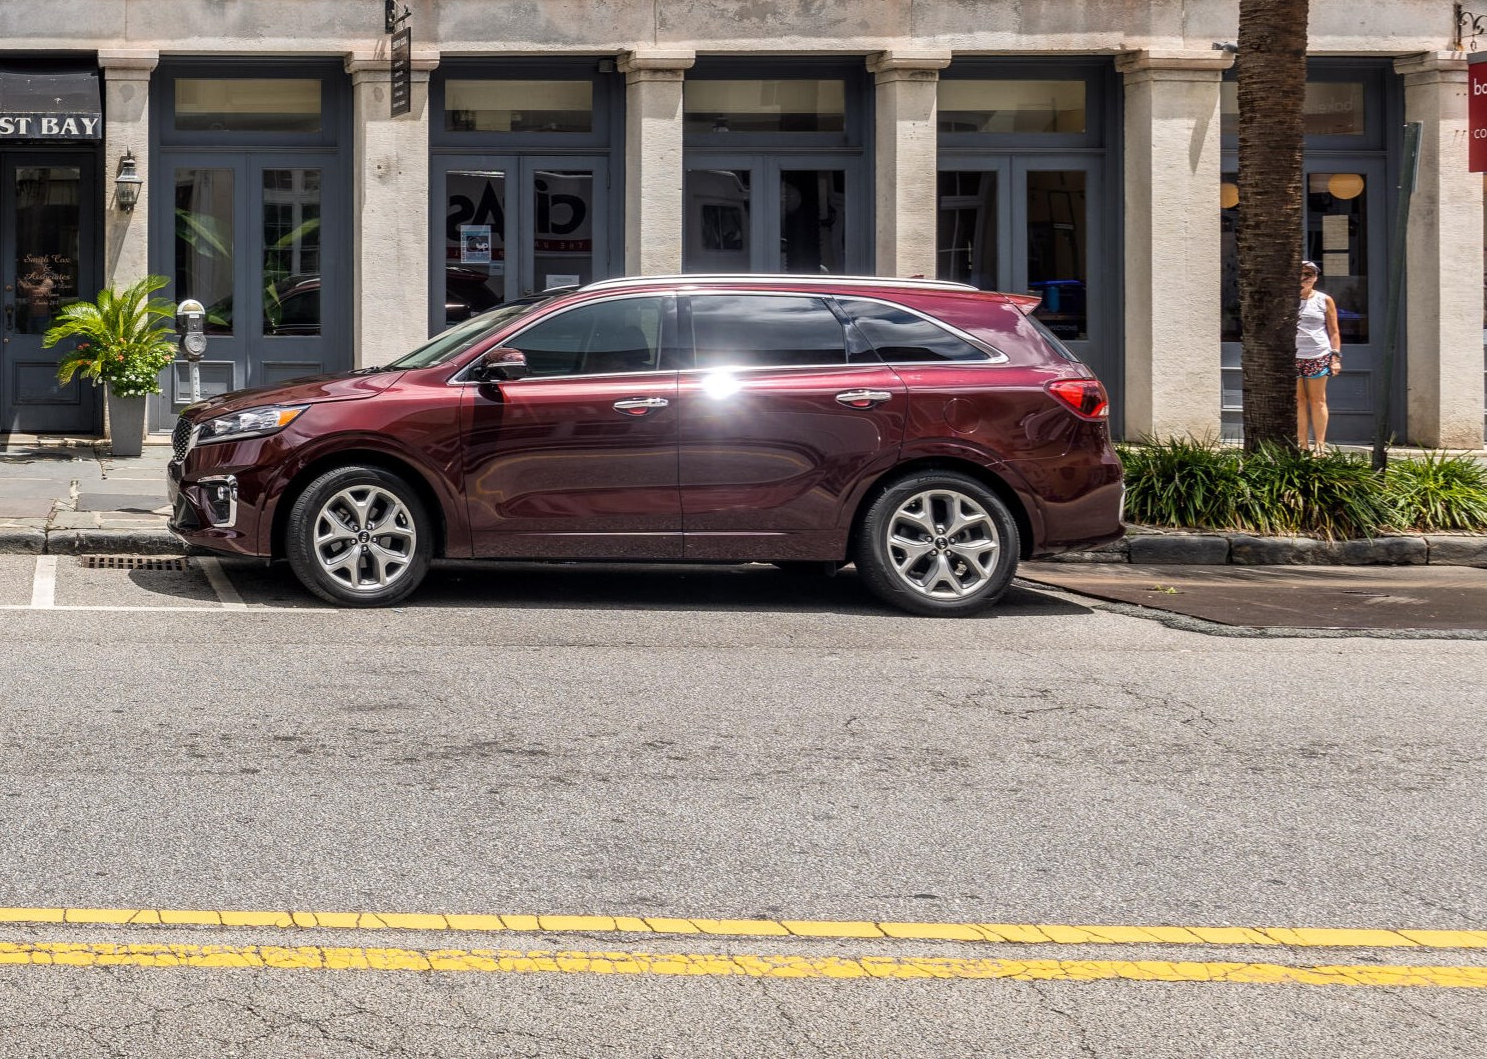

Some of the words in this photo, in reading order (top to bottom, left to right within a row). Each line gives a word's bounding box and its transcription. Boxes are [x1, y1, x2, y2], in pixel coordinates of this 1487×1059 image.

[41, 117, 99, 135] BAY
[23, 253, 49, 263] Smith
[51, 254, 71, 264] Cox
[24, 272, 71, 281] Associates
